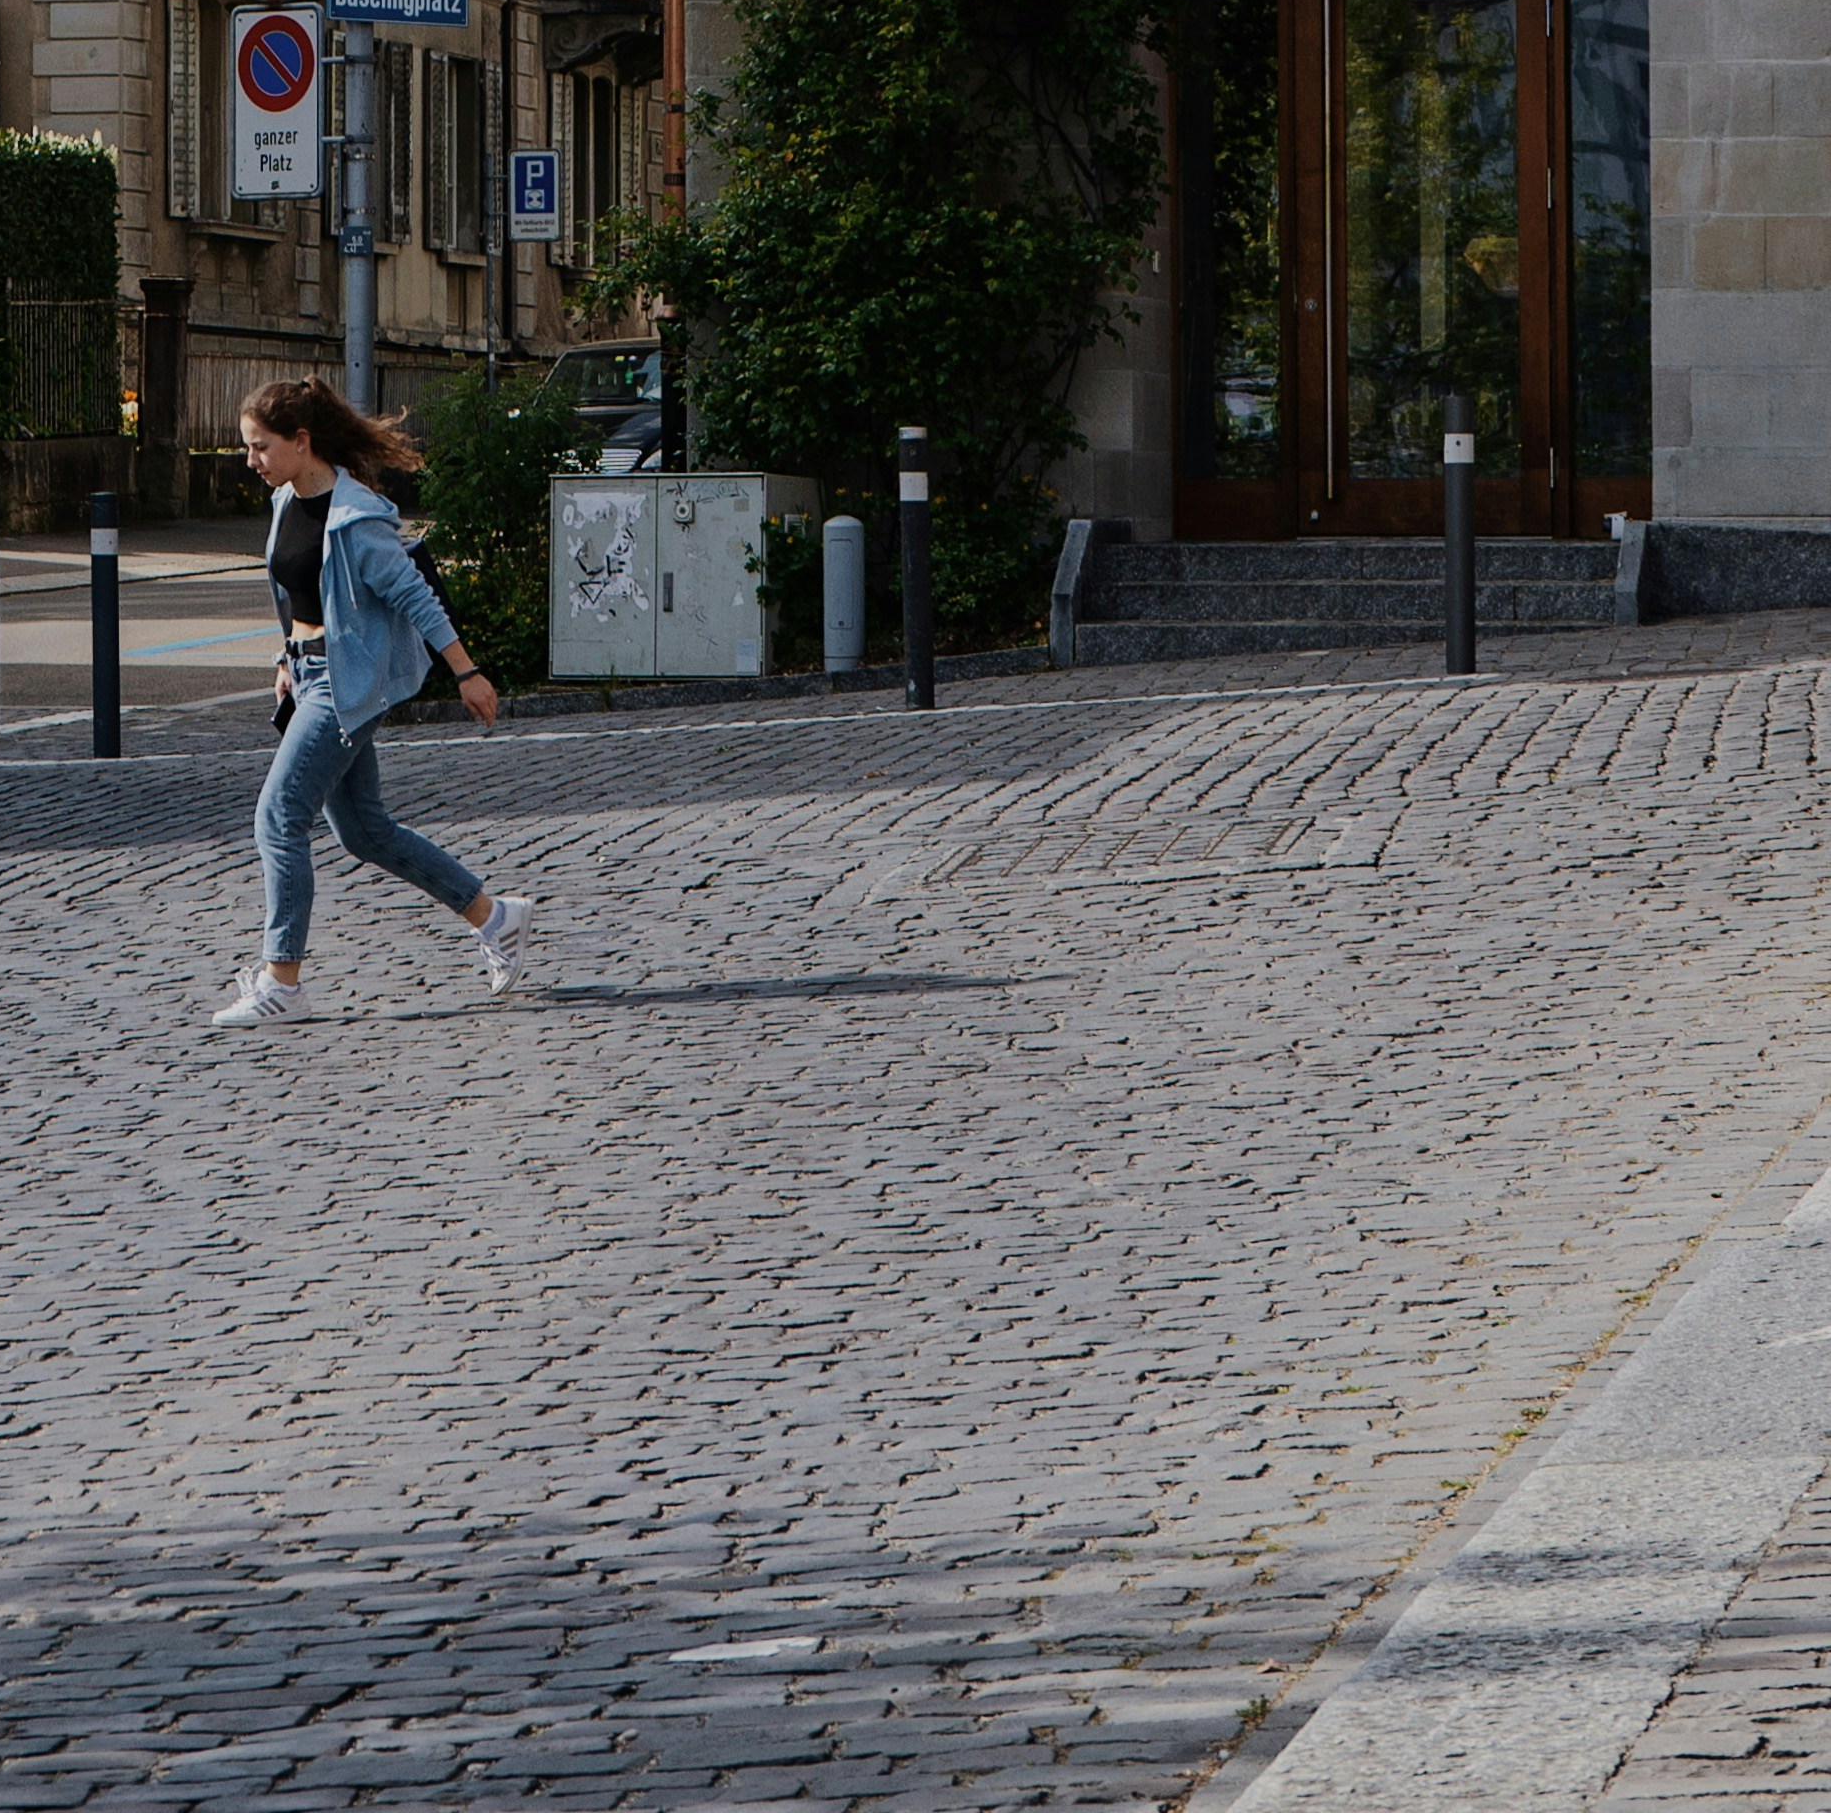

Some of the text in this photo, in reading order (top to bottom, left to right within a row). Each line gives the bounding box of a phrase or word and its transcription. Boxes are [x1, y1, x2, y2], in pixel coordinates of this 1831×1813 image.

[254, 130, 298, 150] ganzer
[260, 153, 293, 172] Platz
[526, 160, 545, 188] P
